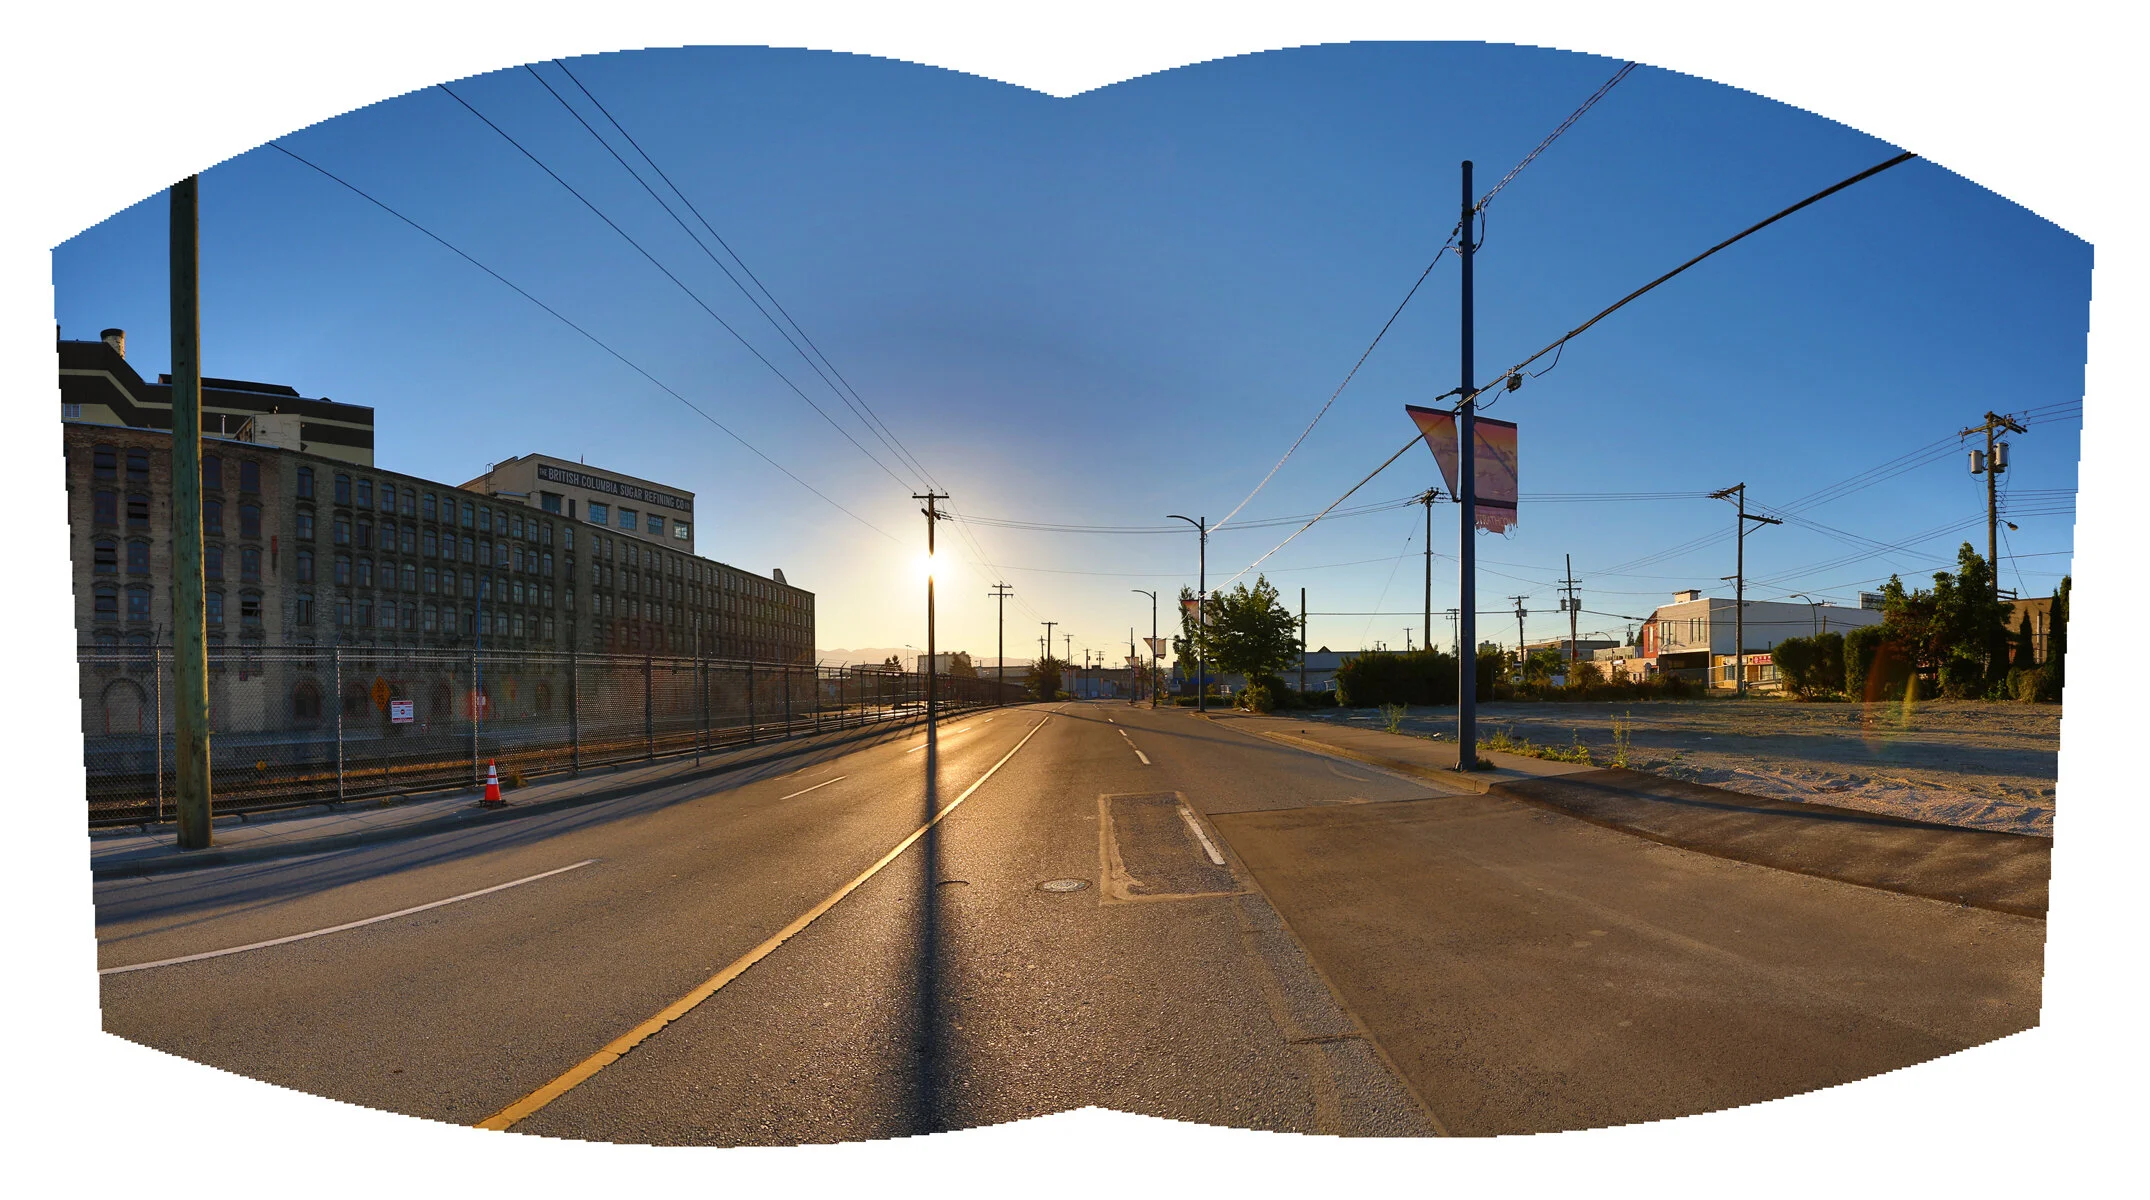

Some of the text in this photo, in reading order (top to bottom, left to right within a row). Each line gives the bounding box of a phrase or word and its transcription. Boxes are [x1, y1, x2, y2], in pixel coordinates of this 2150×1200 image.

[548, 468, 579, 486] BRITISH
[581, 475, 618, 494] COLUMBIA
[620, 484, 643, 500] SUGAR
[644, 490, 675, 508] REFINING
